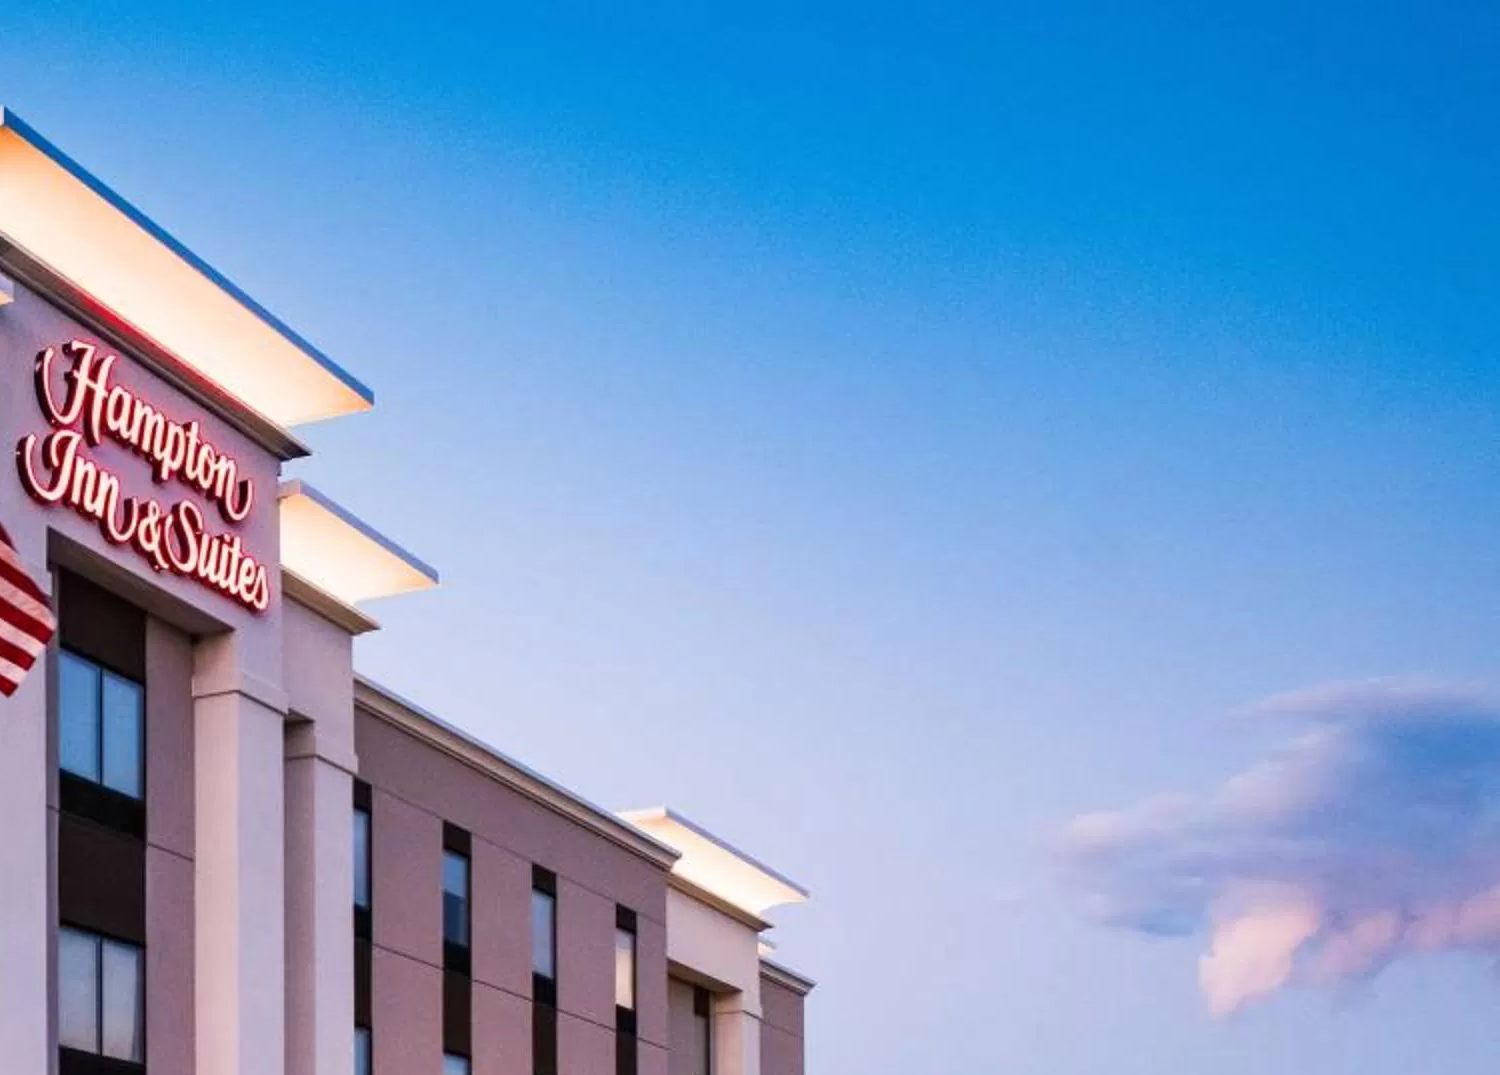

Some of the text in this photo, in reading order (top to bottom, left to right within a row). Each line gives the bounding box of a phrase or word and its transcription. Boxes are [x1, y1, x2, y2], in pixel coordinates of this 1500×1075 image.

[17, 430, 138, 544] Inn
[164, 500, 271, 613] Suites
[35, 340, 253, 524] Hampton
